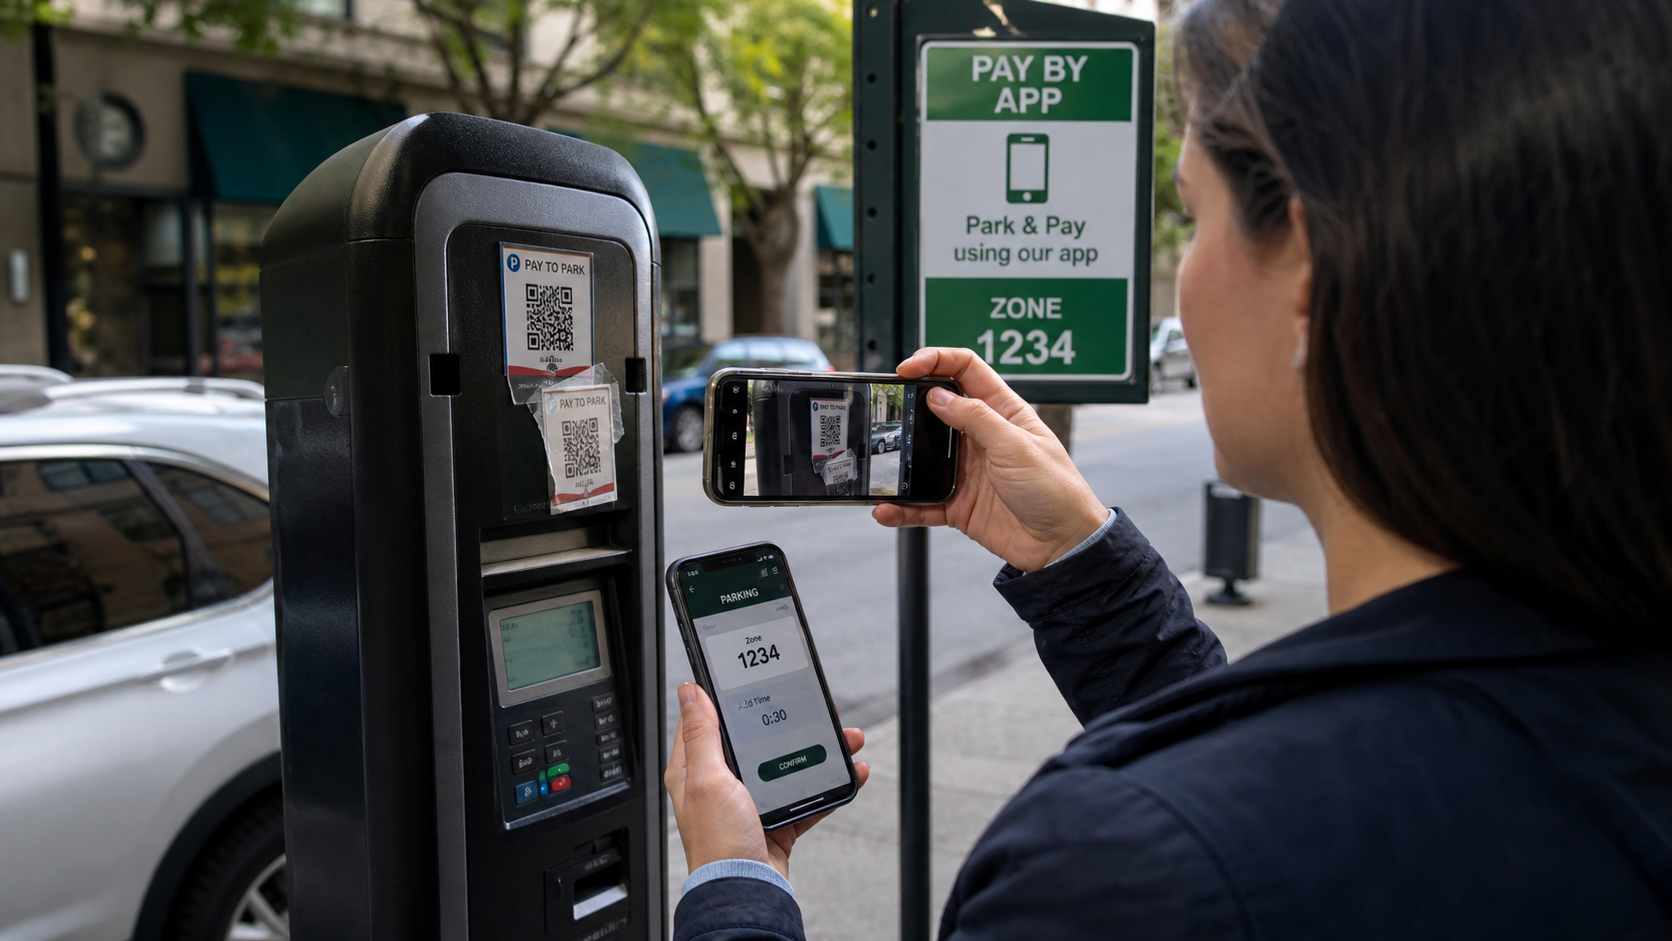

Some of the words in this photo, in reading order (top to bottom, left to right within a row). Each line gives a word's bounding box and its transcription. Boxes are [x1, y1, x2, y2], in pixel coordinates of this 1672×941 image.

[972, 55, 1033, 83] PAY
[1044, 55, 1088, 83] BY
[994, 87, 1062, 114] APP
[966, 215, 1015, 235] Park
[1023, 216, 1038, 235] &
[1046, 215, 1087, 239] Pay
[954, 243, 1011, 266] using
[1018, 246, 1053, 262] our
[1059, 246, 1099, 266] app
[525, 259, 543, 272] PAY
[545, 261, 559, 273] TO
[561, 263, 586, 276] PARK
[990, 297, 1063, 320] ZONE
[977, 329, 1077, 365] 1234
[559, 397, 574, 409] PAY
[575, 397, 586, 408] TO
[587, 395, 607, 406] PARK
[720, 587, 759, 605] PARKING
[737, 644, 781, 669] 1234
[753, 694, 771, 706] Time
[761, 709, 787, 726] 0:30
